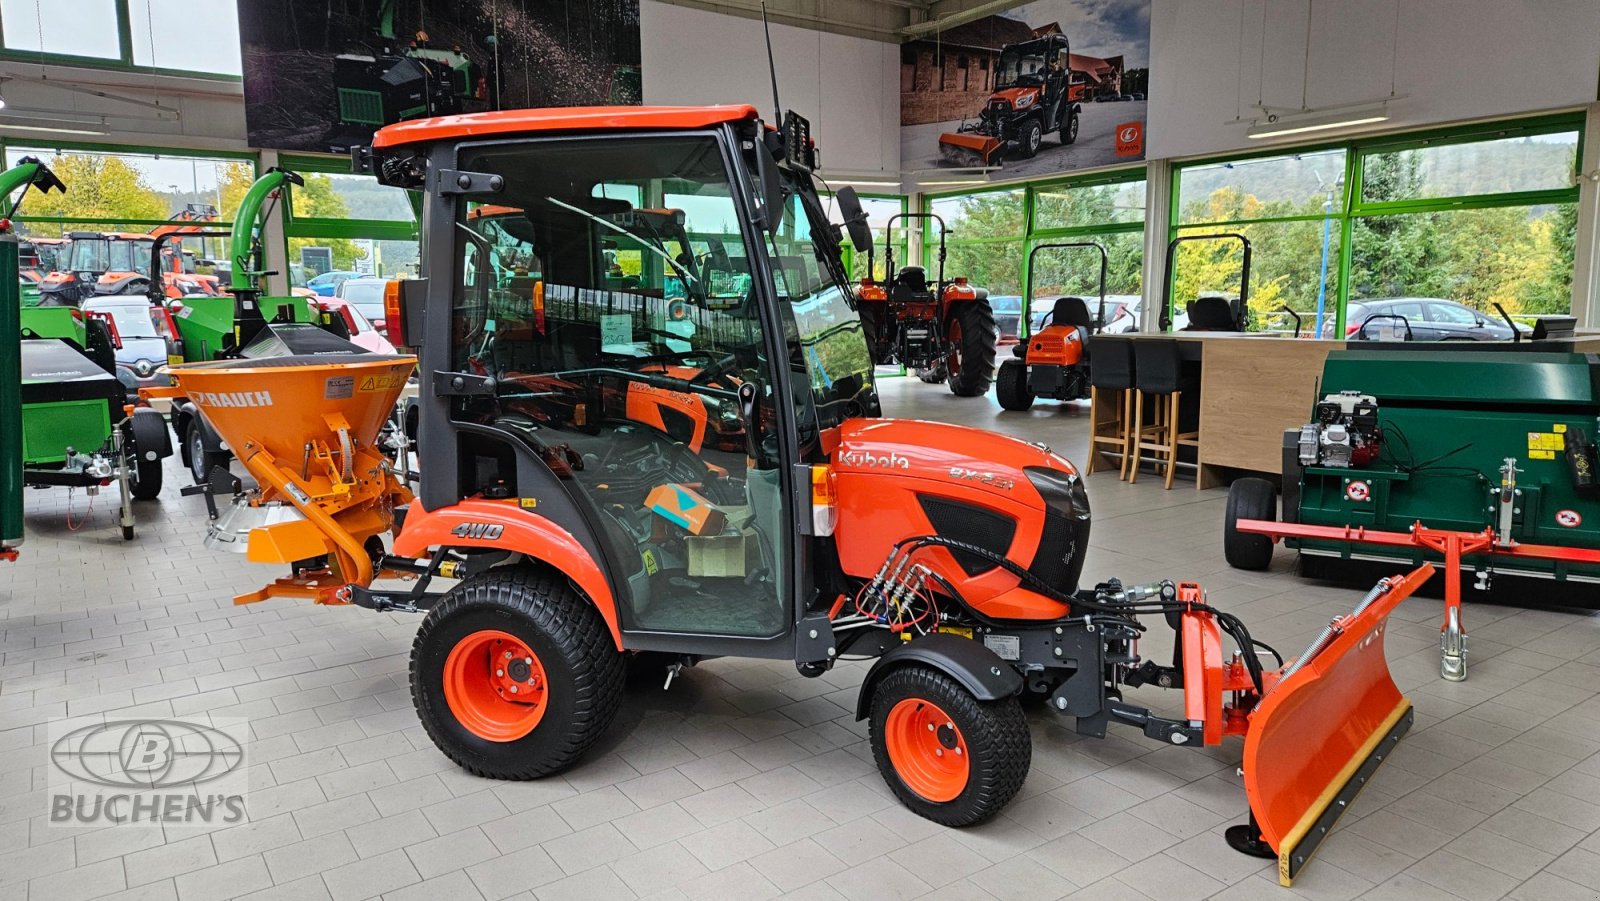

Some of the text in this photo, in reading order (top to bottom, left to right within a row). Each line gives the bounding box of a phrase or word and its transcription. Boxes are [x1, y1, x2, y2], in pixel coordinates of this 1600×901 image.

[206, 391, 273, 407] RAUCH
[838, 450, 909, 469] Kubota
[451, 522, 504, 540] 4WD
